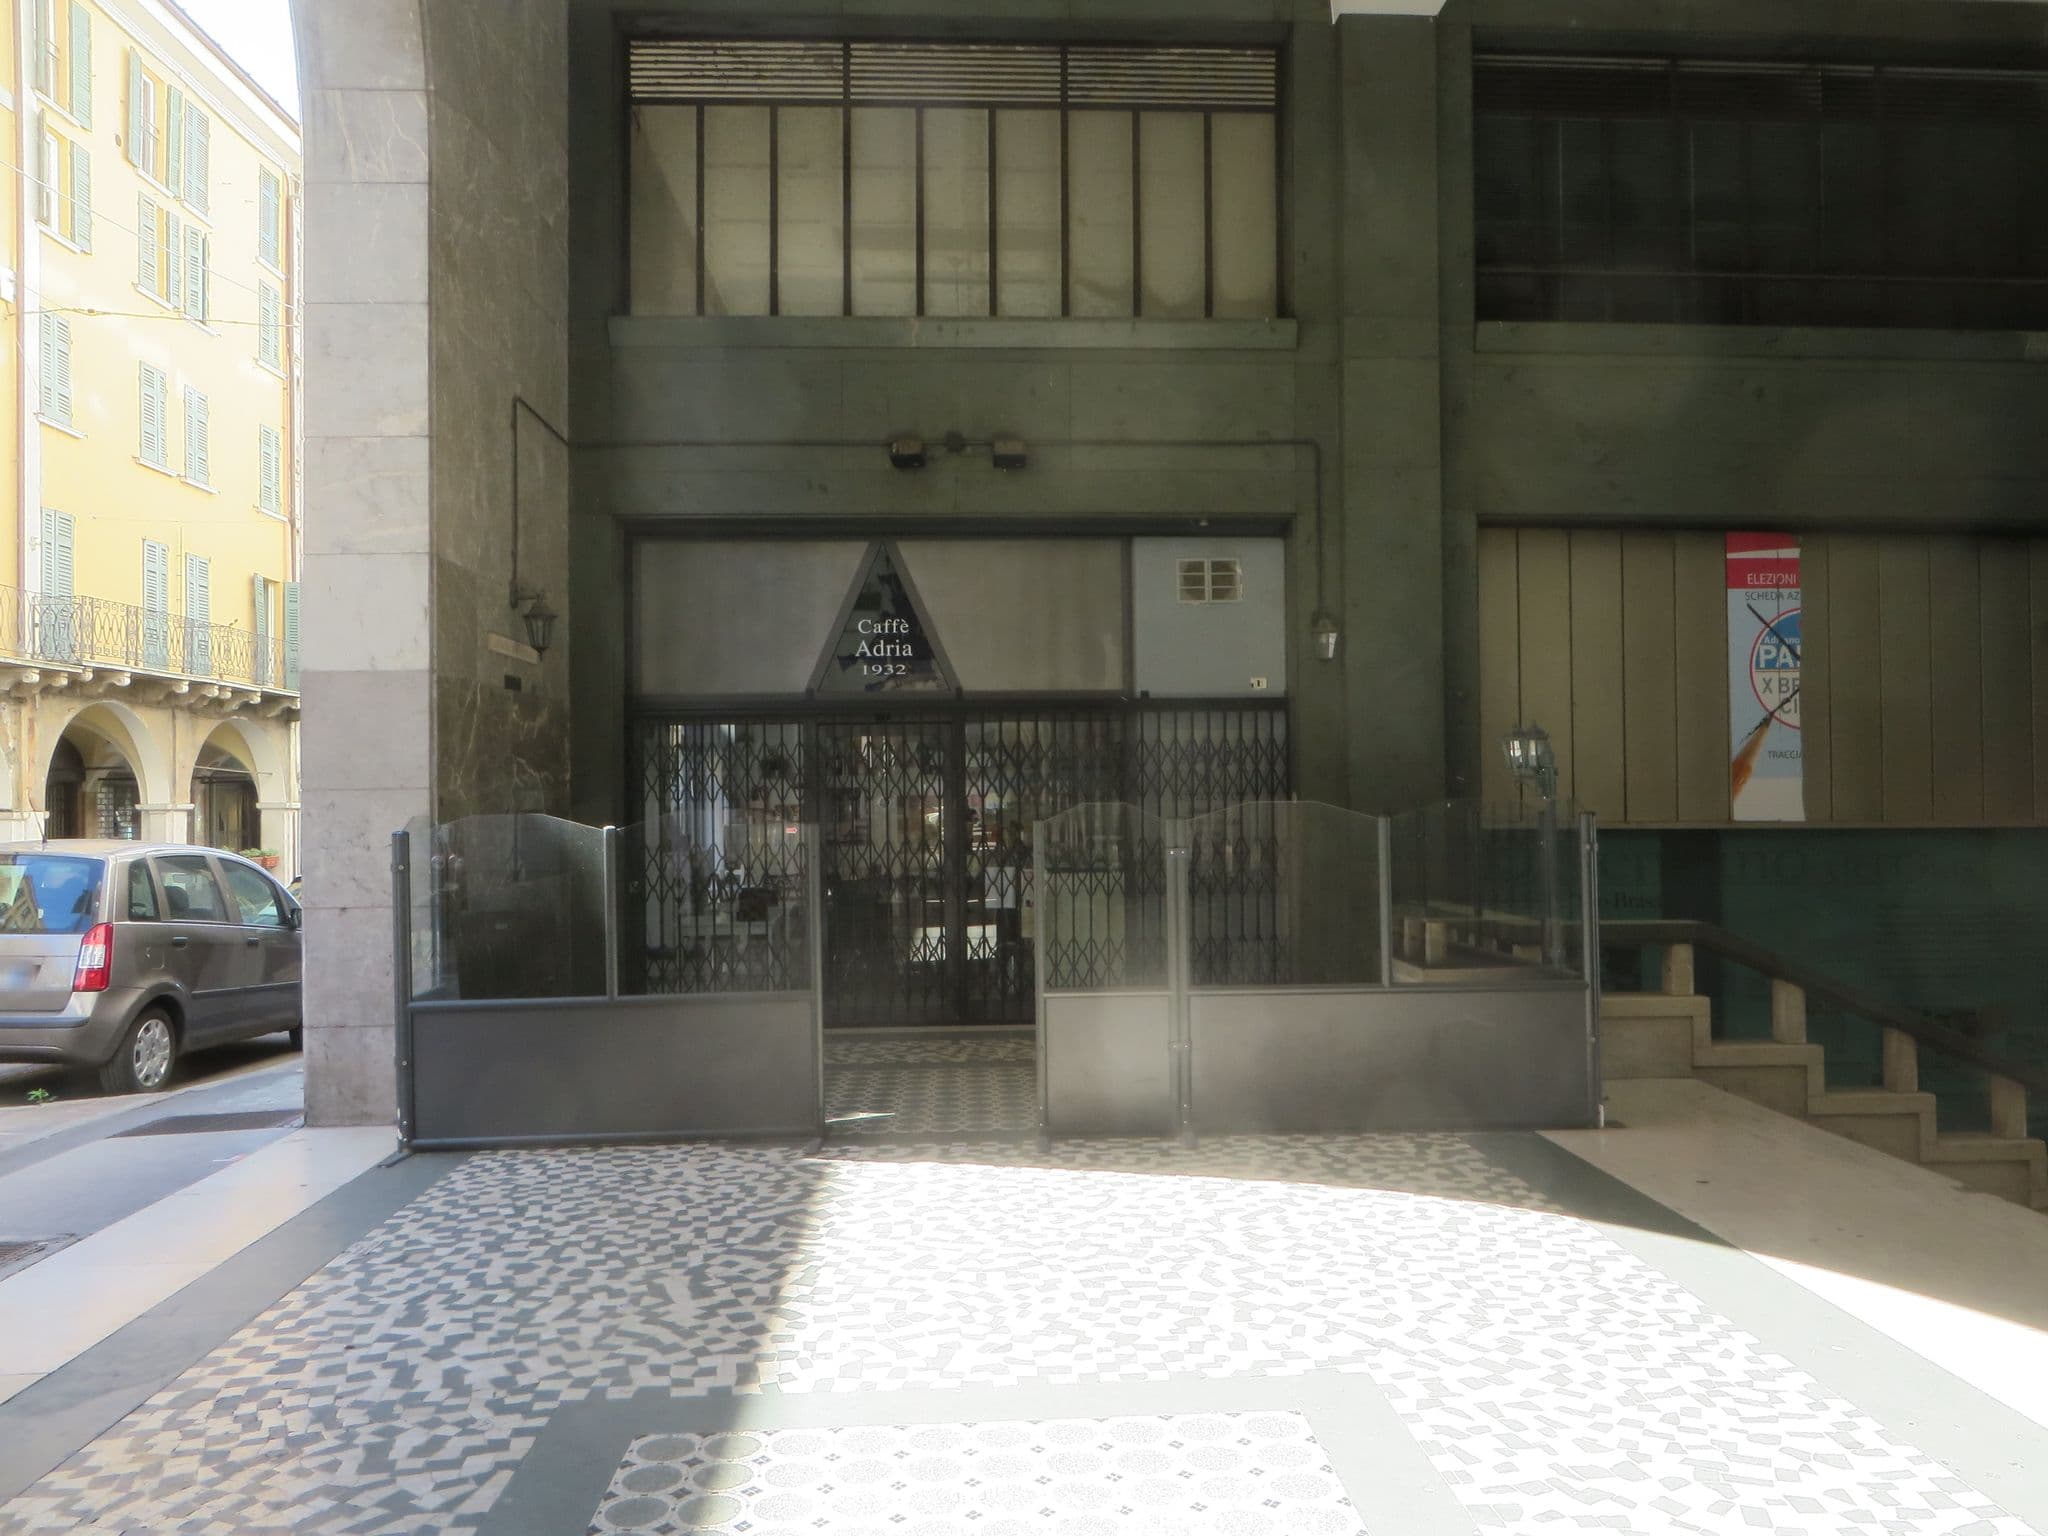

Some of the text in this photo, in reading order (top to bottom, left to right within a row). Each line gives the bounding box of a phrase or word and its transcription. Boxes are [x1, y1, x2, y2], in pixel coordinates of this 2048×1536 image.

[1747, 573, 1797, 585] ELEZIONI
[1744, 591, 1784, 601] SCHEDA
[857, 619, 910, 634] Caffè
[855, 639, 913, 657] Adria
[1759, 644, 1800, 669] PA
[863, 664, 907, 676] 1932
[1762, 677, 1773, 694] X
